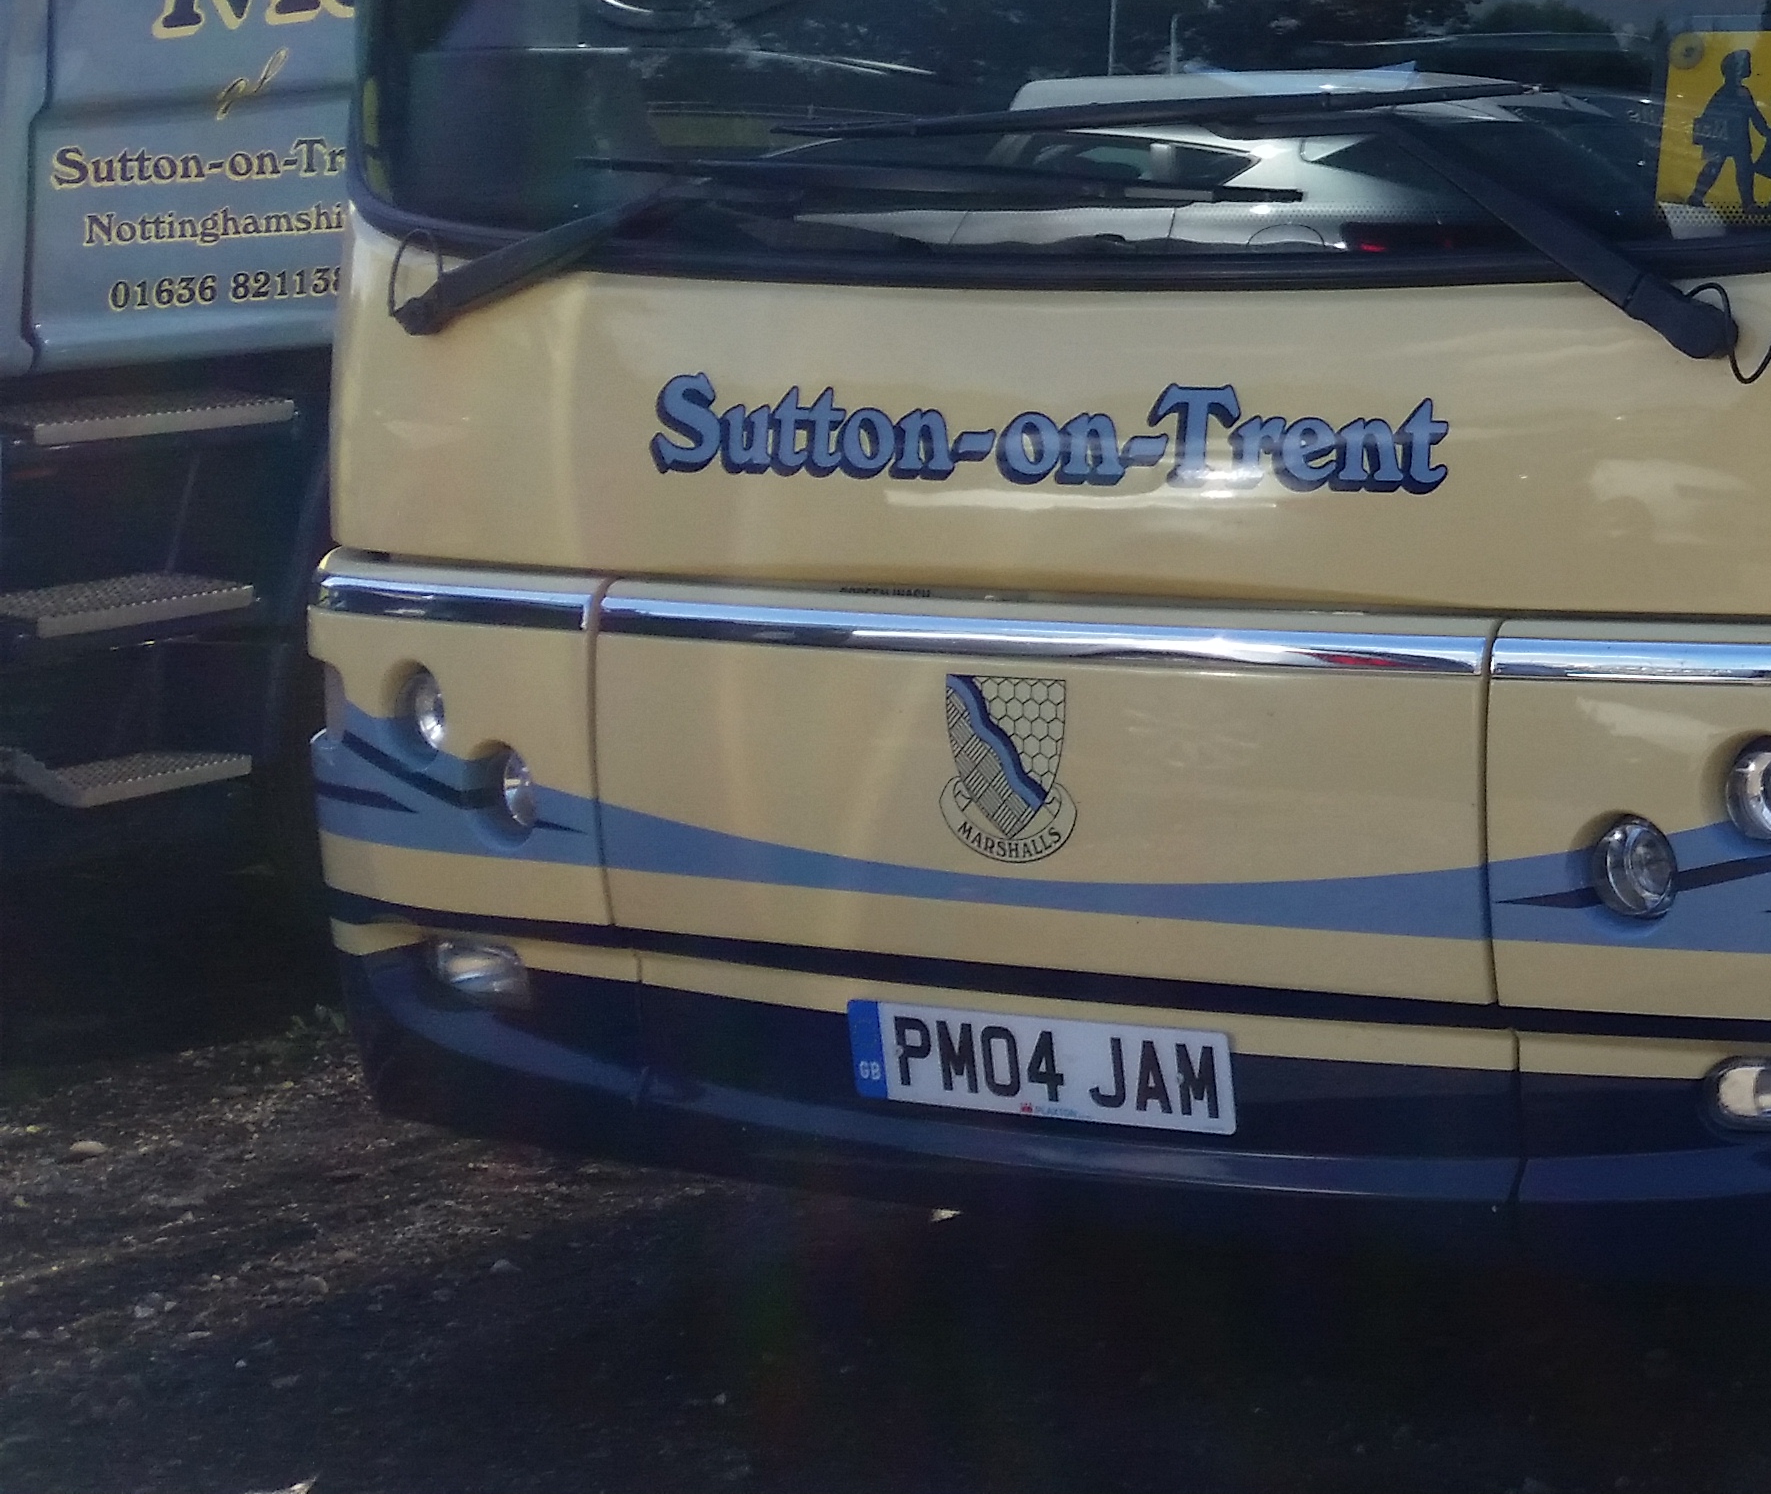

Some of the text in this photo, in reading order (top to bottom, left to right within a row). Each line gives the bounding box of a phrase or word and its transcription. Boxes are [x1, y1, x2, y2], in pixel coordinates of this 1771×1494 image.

[51, 136, 346, 190] Sutton-on-Tr
[83, 201, 346, 247] Nottinghamshi
[109, 272, 219, 312] 01636
[652, 372, 1450, 495] Sutton-on-Trent
[957, 821, 1062, 859] MARSHALLS
[859, 1059, 882, 1080] GB
[893, 1016, 1220, 1120] PM04 JAM
